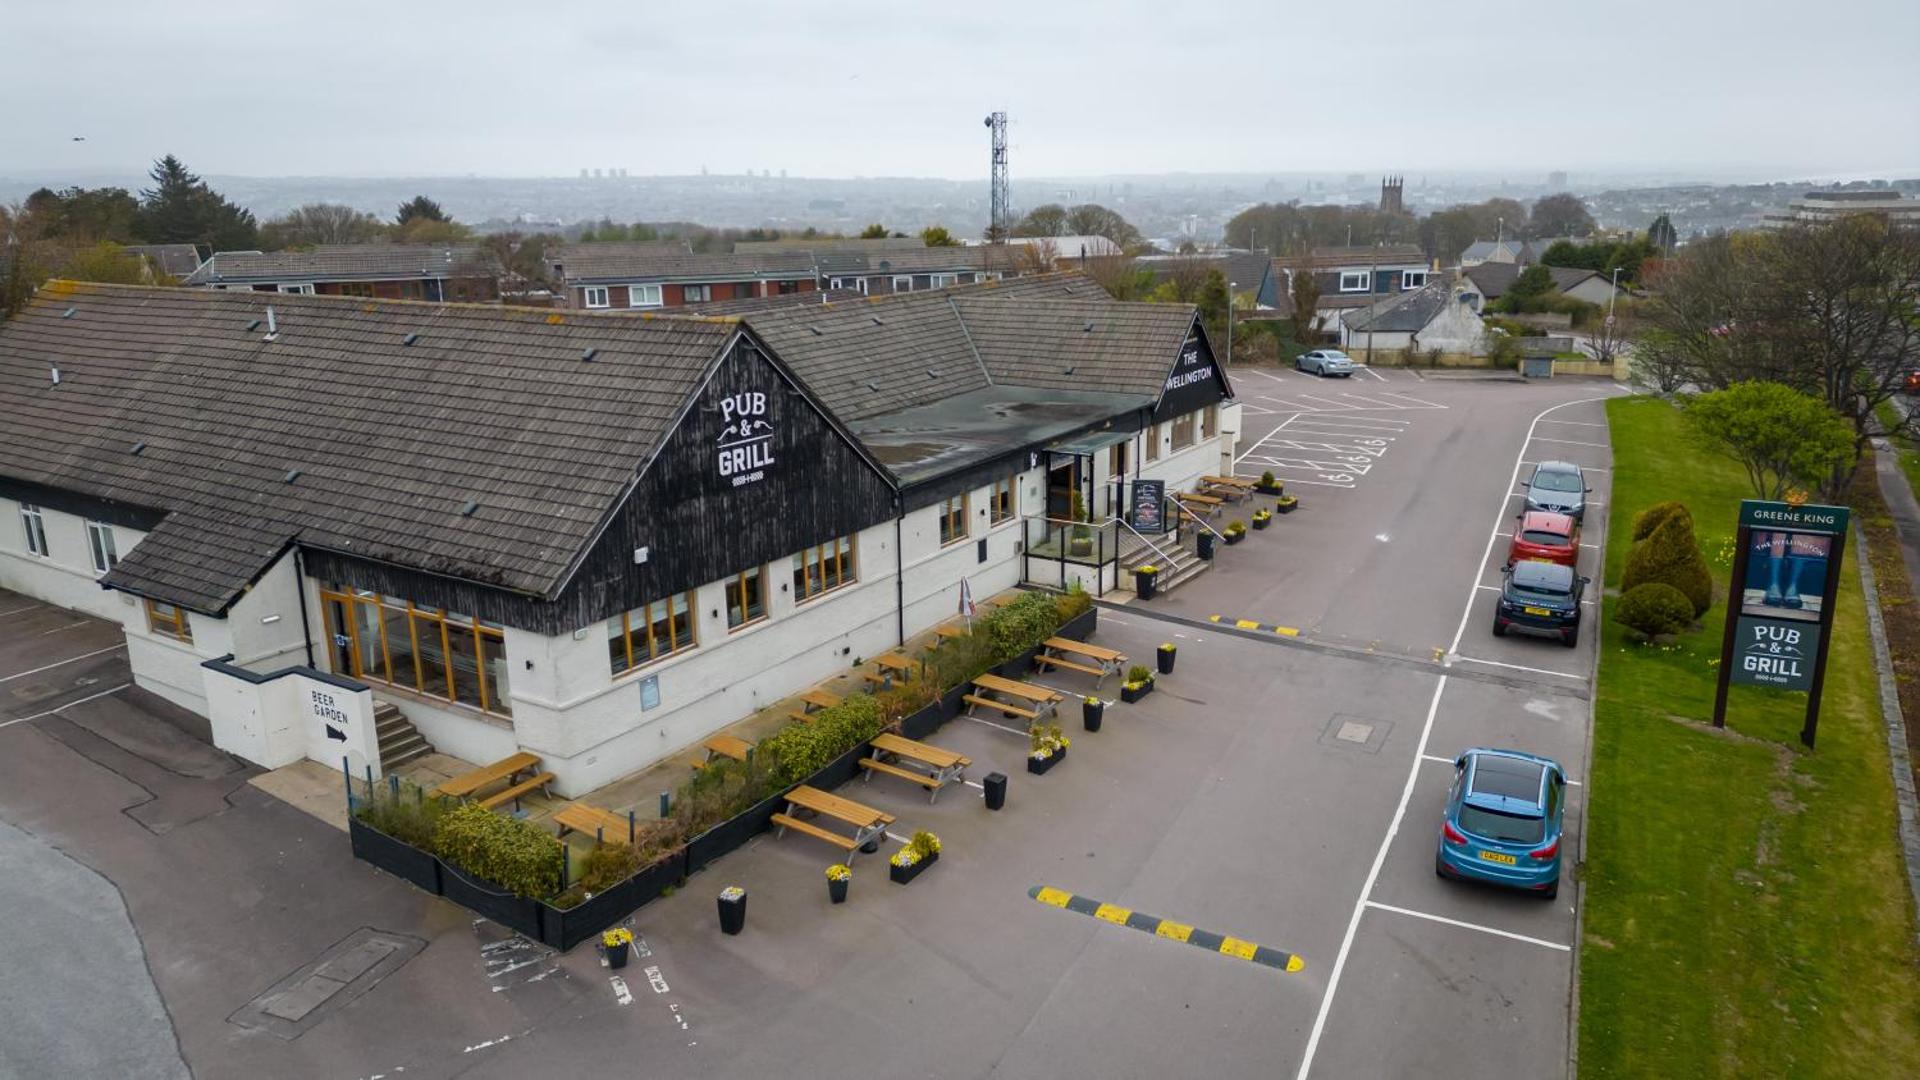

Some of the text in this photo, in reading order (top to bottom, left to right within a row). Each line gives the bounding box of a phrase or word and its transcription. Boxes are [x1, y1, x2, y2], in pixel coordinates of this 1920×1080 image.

[1183, 351, 1198, 366] THE
[1166, 366, 1212, 391] WELLINGTON
[720, 392, 766, 422] PUB
[740, 419, 752, 437] &
[719, 441, 775, 477] GRILL
[1753, 510, 1800, 522] GREENE
[1804, 514, 1835, 524] KING
[1753, 625, 1801, 645] PUB
[1769, 641, 1781, 654] &
[1744, 655, 1802, 677] GRILL
[312, 690, 335, 706] BEER
[314, 704, 349, 724] GARDEN
